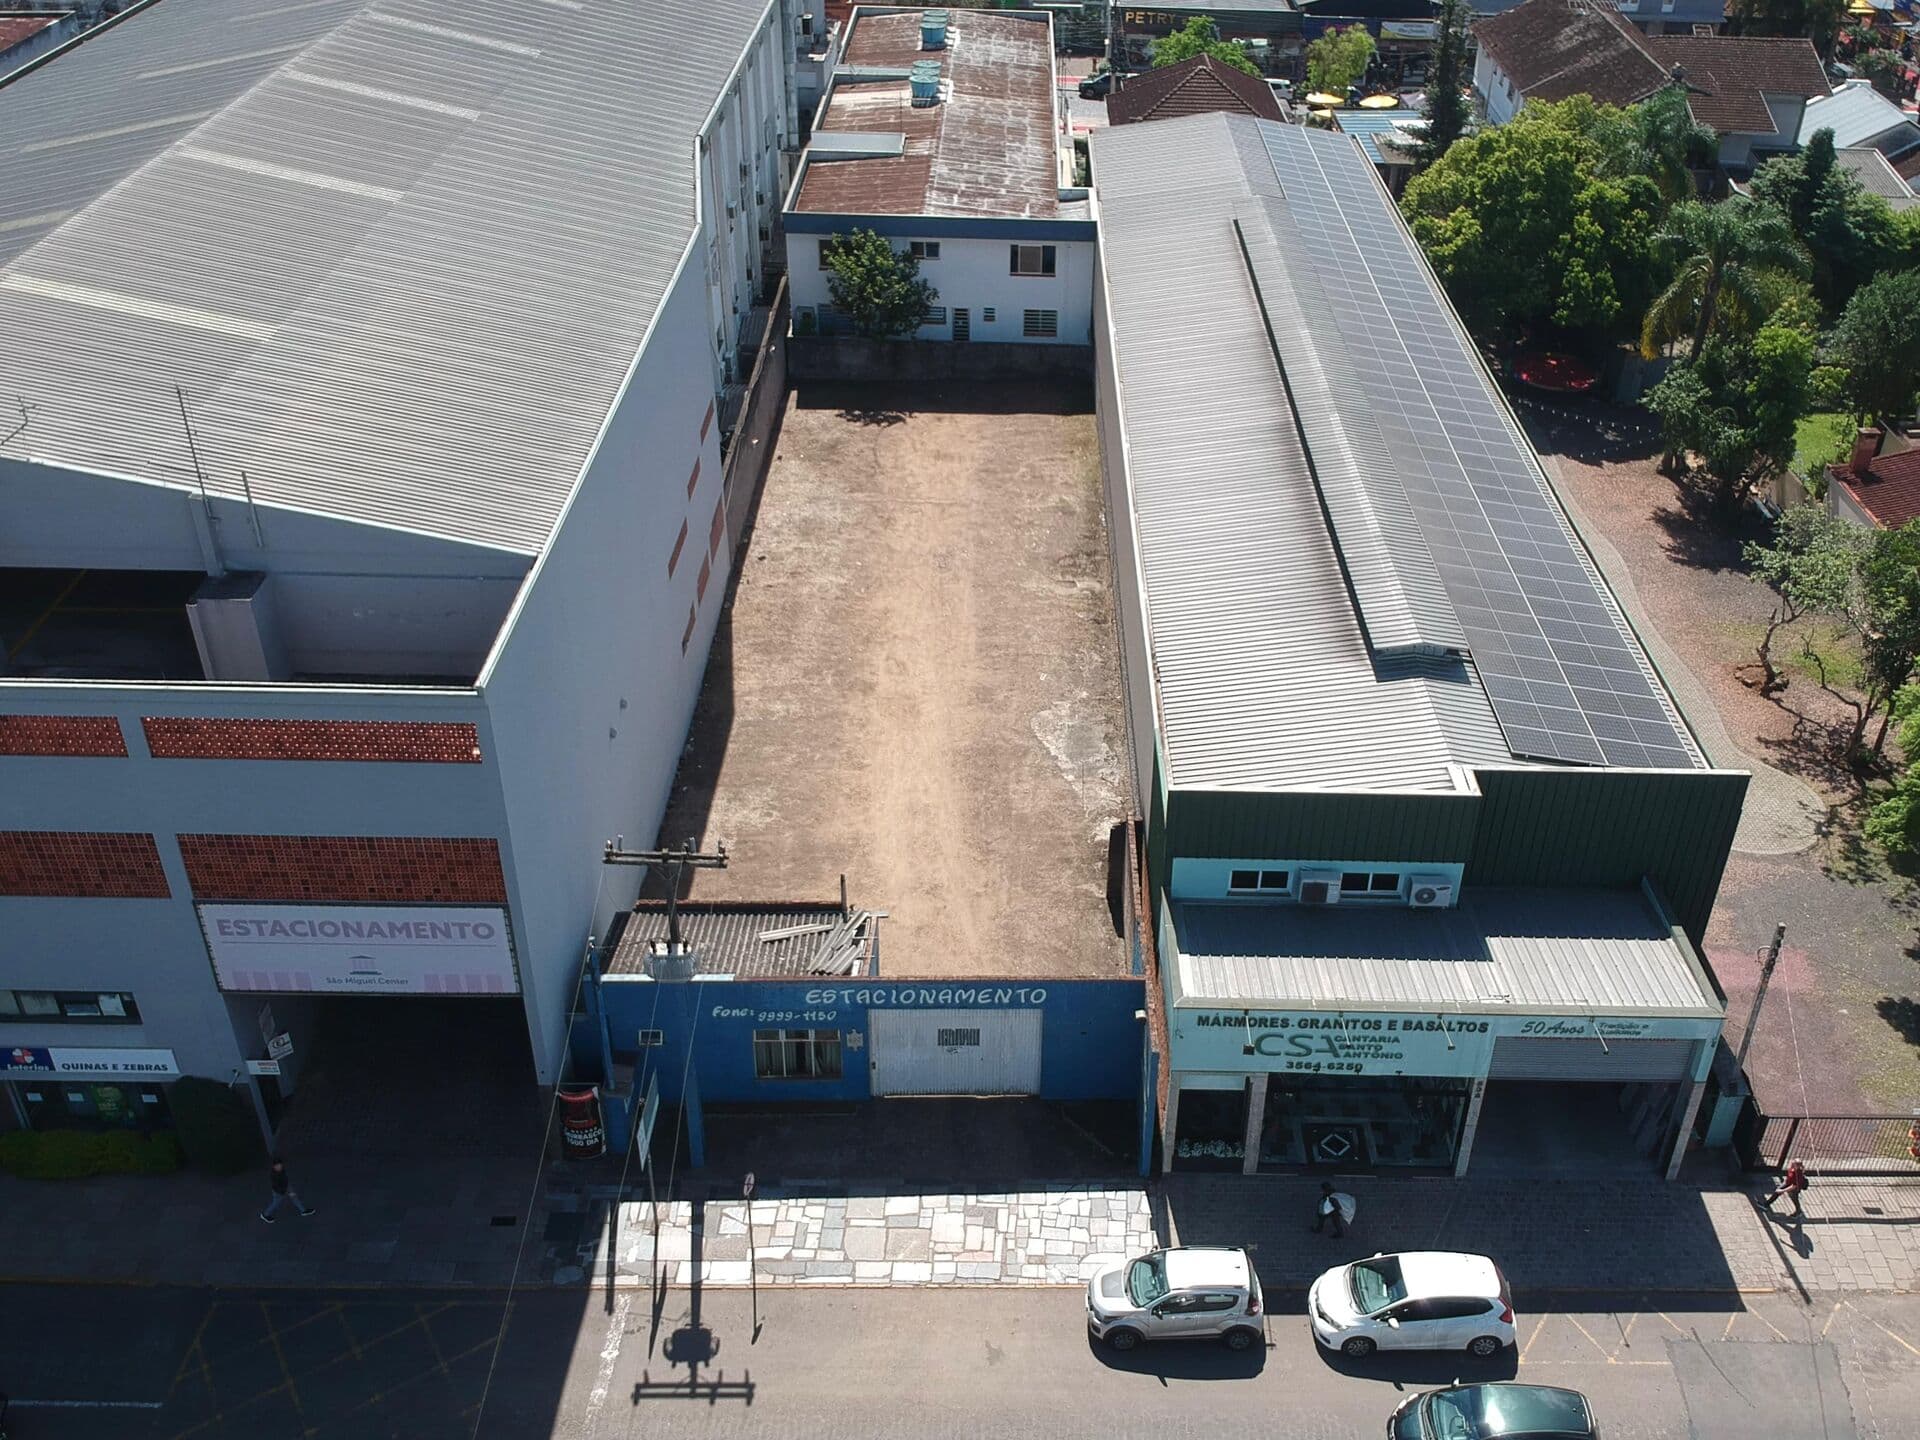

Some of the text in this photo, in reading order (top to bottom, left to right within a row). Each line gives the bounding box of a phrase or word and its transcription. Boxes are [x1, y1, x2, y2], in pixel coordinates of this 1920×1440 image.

[1125, 11, 1176, 25] PETRY
[216, 918, 495, 940] ESTACIONAMENTO
[805, 988, 1047, 1005] ESTACIONAMENTO
[1387, 1019, 1398, 1031] E
[1402, 1019, 1490, 1034] BASALTOS
[1521, 1020, 1546, 1034] 50
[1255, 1032, 1341, 1058] CSA
[61, 1063, 169, 1072] QUINAS E ZEBRAS
